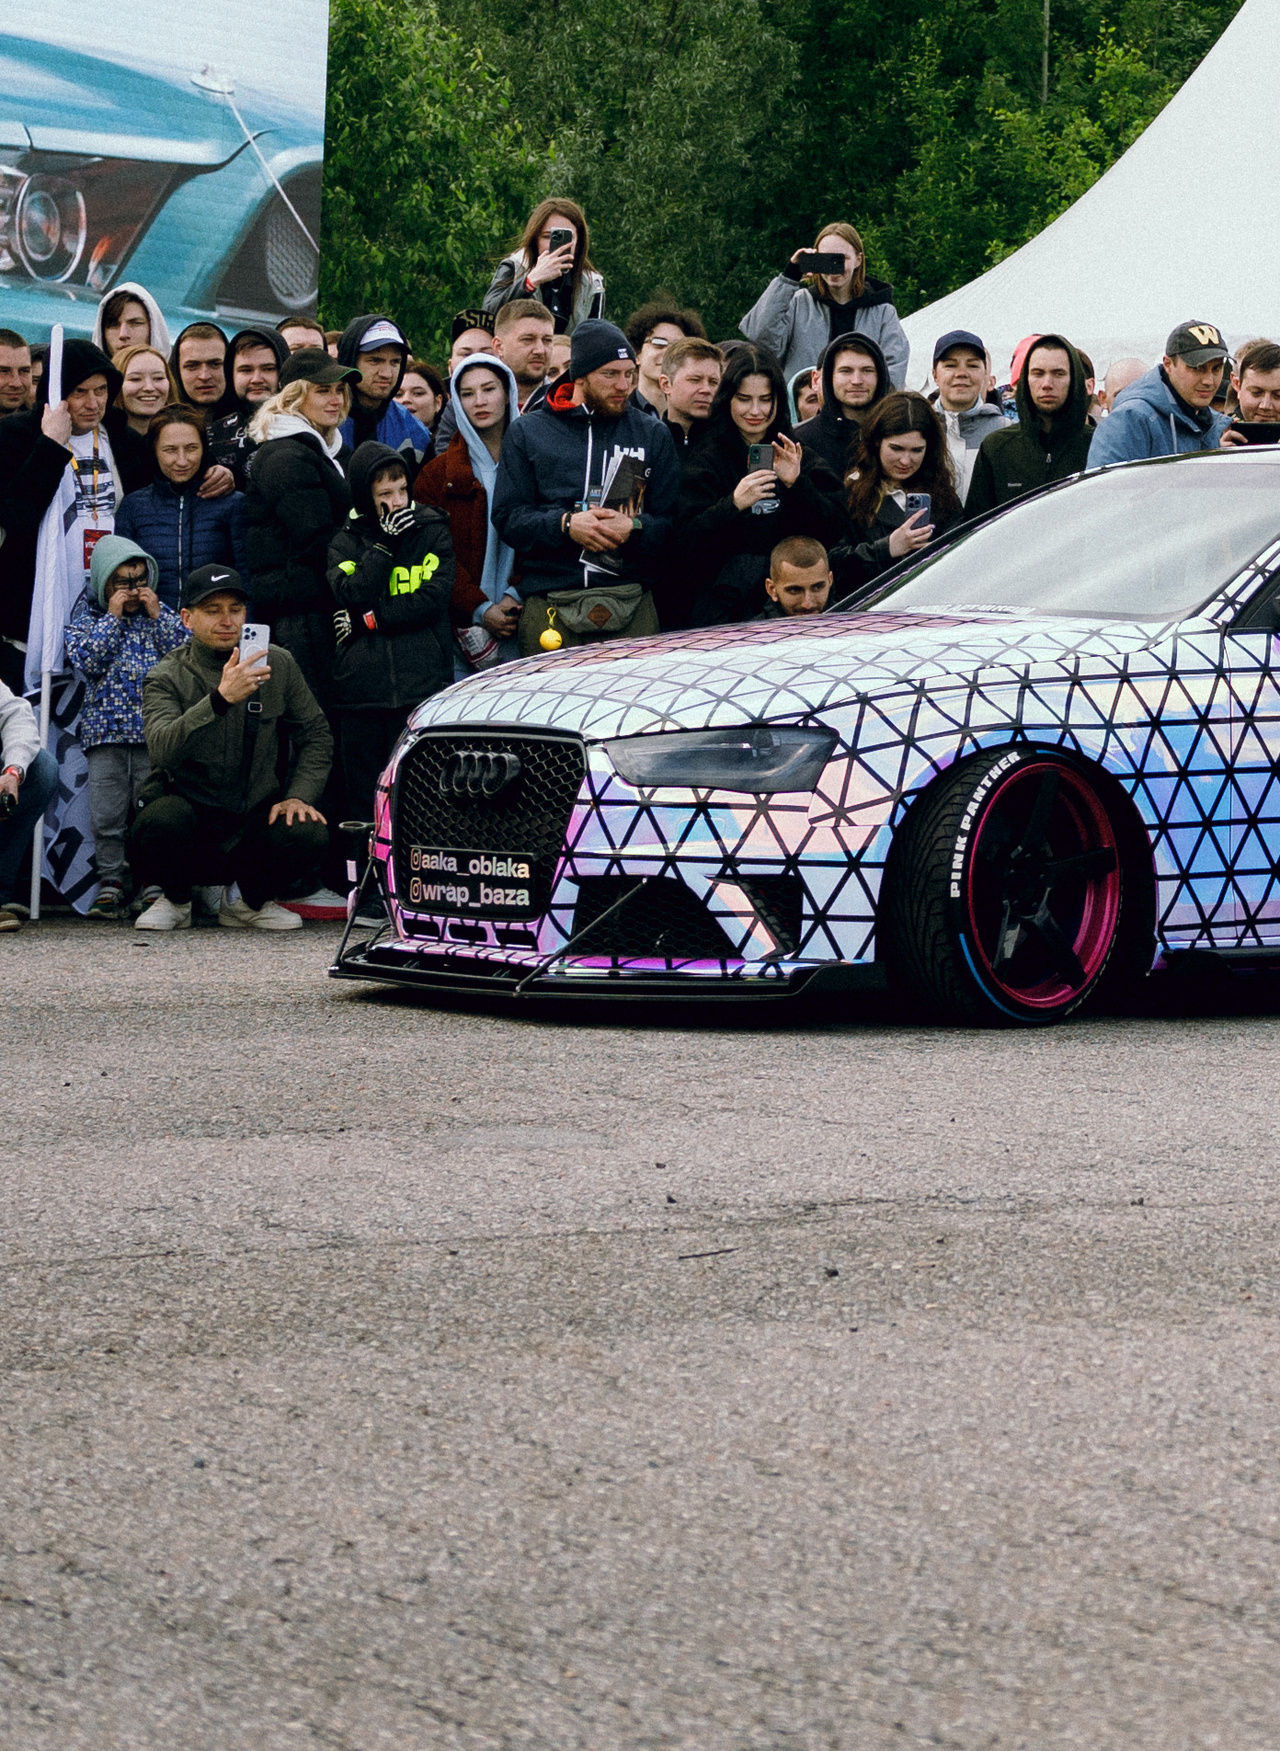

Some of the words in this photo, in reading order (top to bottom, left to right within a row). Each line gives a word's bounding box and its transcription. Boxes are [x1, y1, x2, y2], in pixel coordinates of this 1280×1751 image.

[1187, 325, 1220, 345] W
[950, 835, 968, 898] PINK
[960, 751, 1021, 831] PANTHER
[421, 851, 530, 879] aaka_oblaka
[422, 882, 530, 907] wrap_baza
